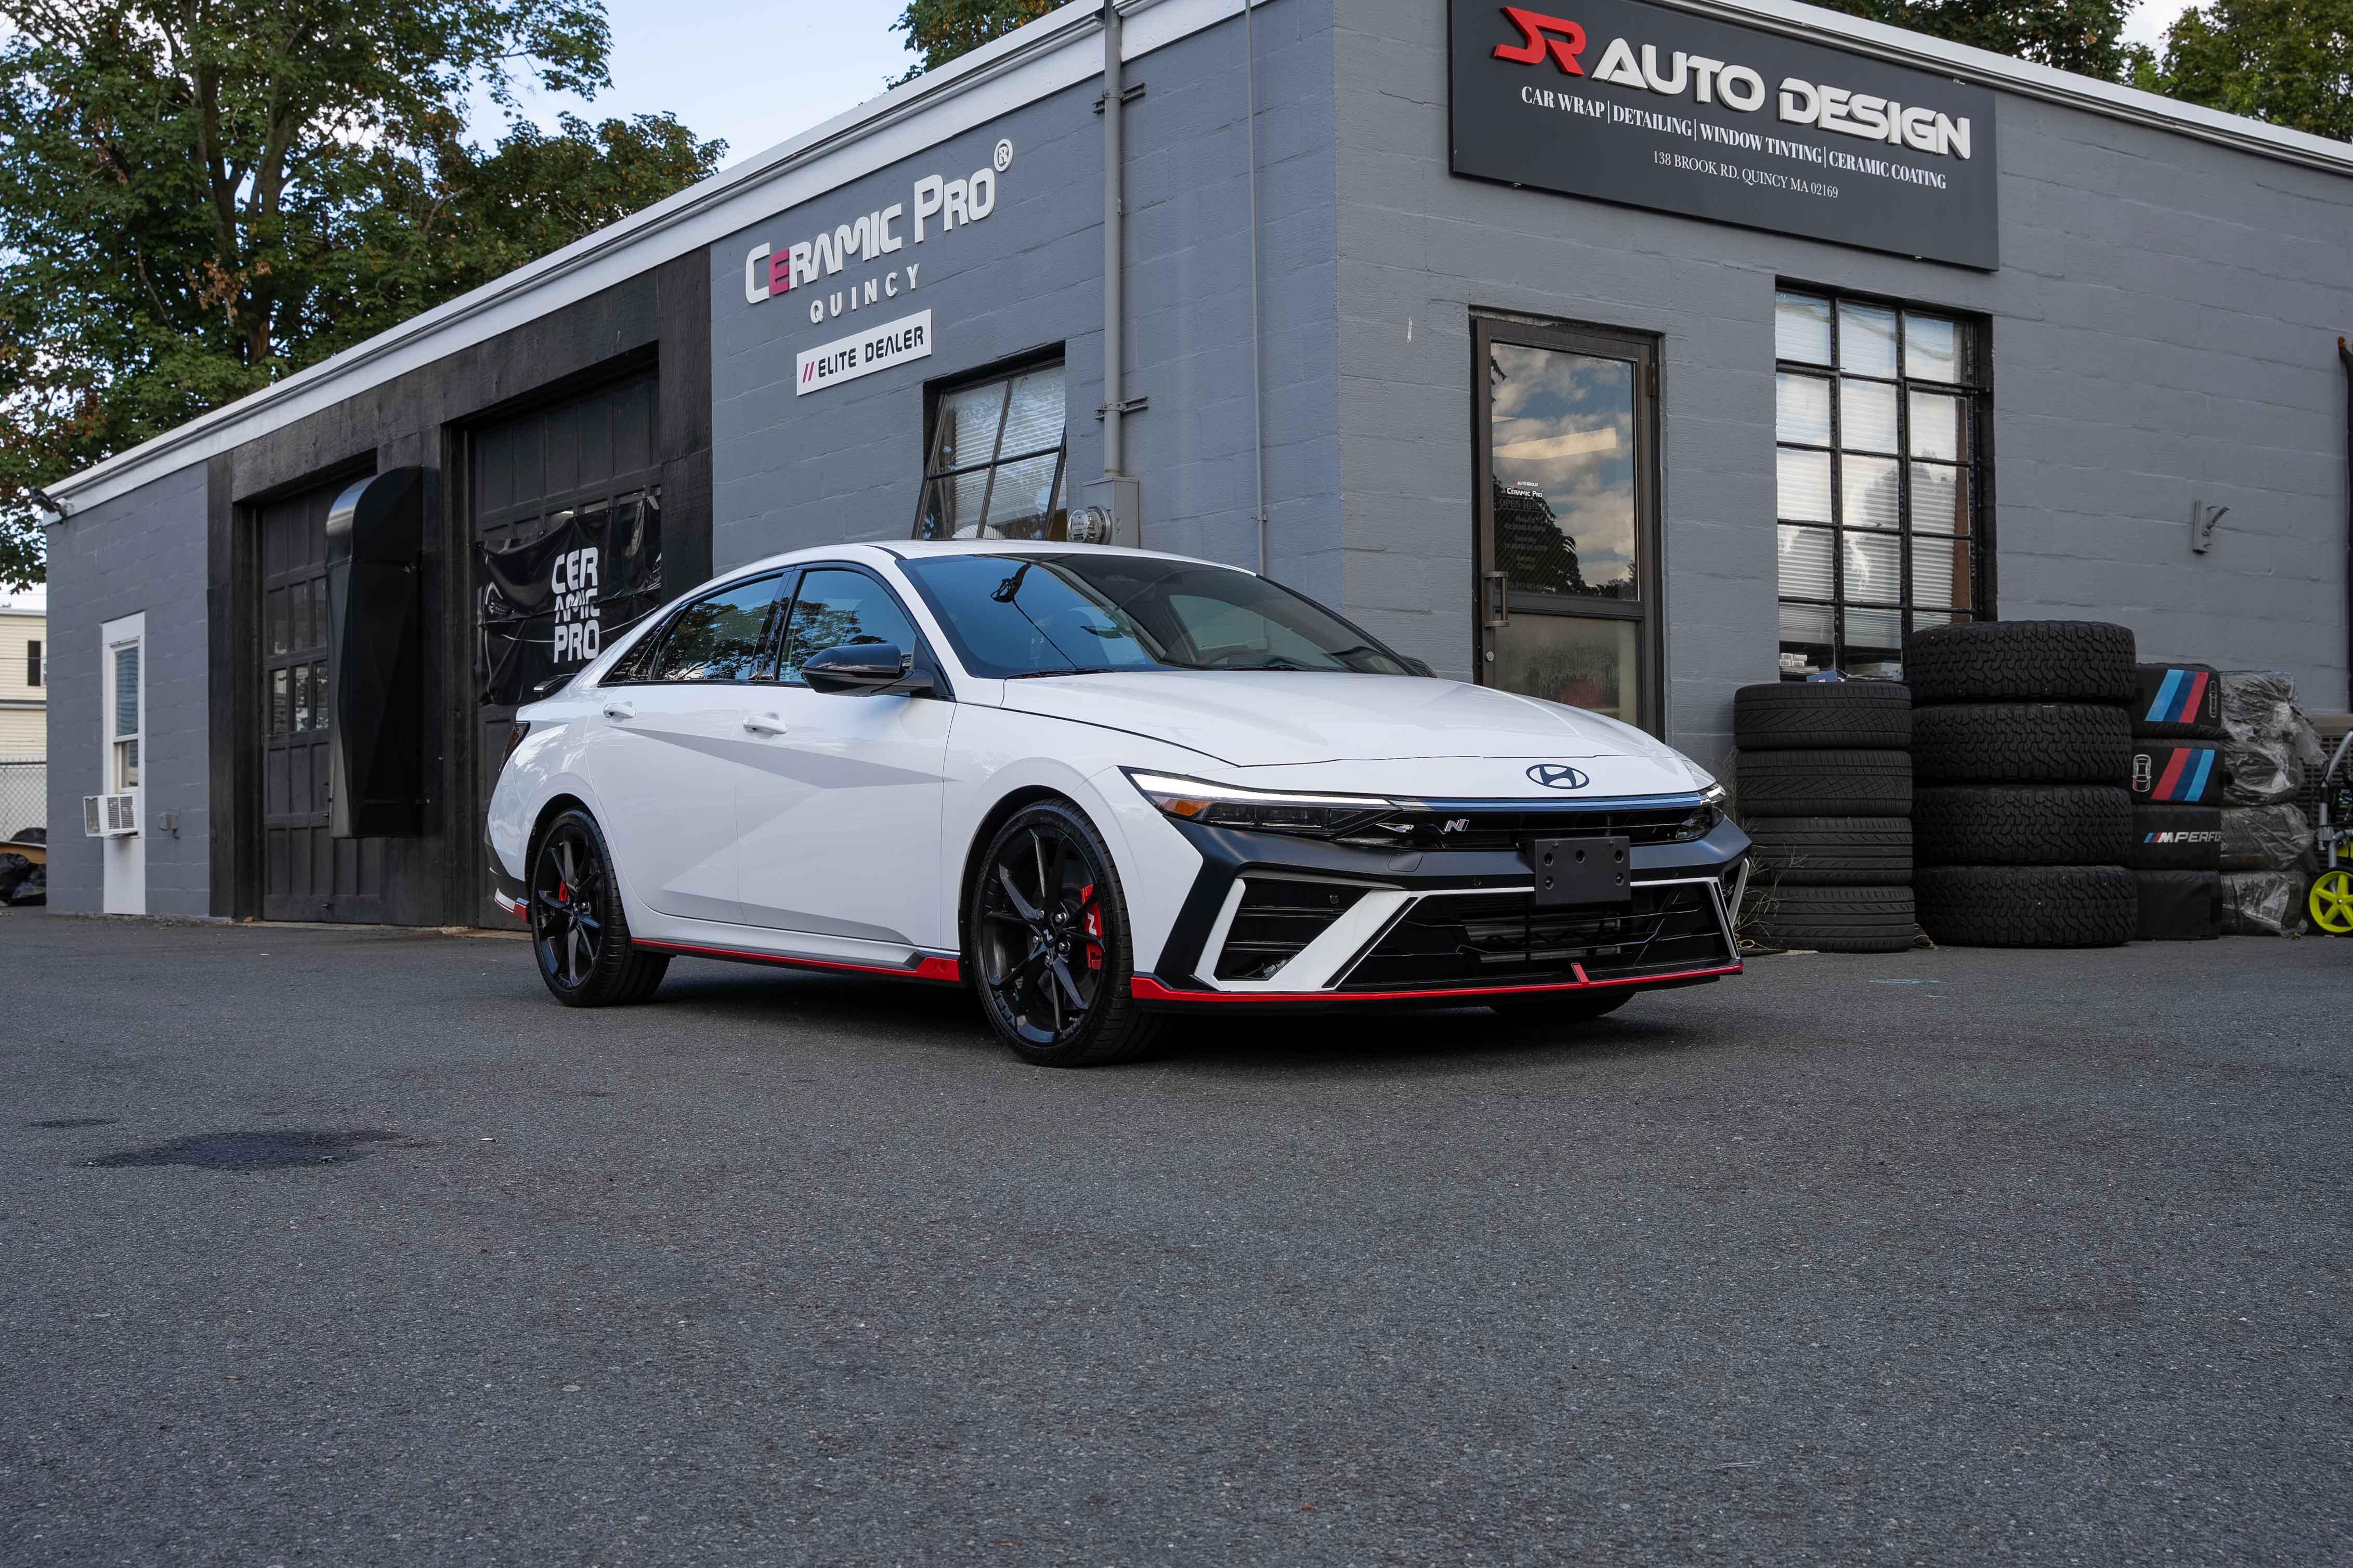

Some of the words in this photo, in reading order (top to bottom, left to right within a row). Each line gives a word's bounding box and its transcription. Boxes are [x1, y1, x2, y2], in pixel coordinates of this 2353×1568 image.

[1591, 37, 1766, 112] AUTO
[1778, 77, 1971, 160] DESIGN
[1521, 86, 1555, 108] CAR
[1558, 91, 1605, 118] WRAP
[1613, 104, 1692, 136] DETAILING
[1700, 122, 1763, 151] WINDOW
[1766, 137, 1822, 163] TINTING
[1829, 150, 1890, 178] CERAMIC
[1891, 163, 1946, 189] COATING
[1653, 150, 1671, 166] 138
[1674, 153, 1718, 174] BROOK
[1720, 163, 1740, 179] RD.
[1743, 169, 1788, 189] QUINCY
[1790, 177, 1809, 193] MA
[1811, 181, 1839, 199] 02169
[809, 263, 920, 324] QUINCY
[818, 347, 857, 378] ELITE
[865, 325, 924, 363] DEALER
[551, 547, 598, 594] CER
[553, 620, 599, 664] PRO
